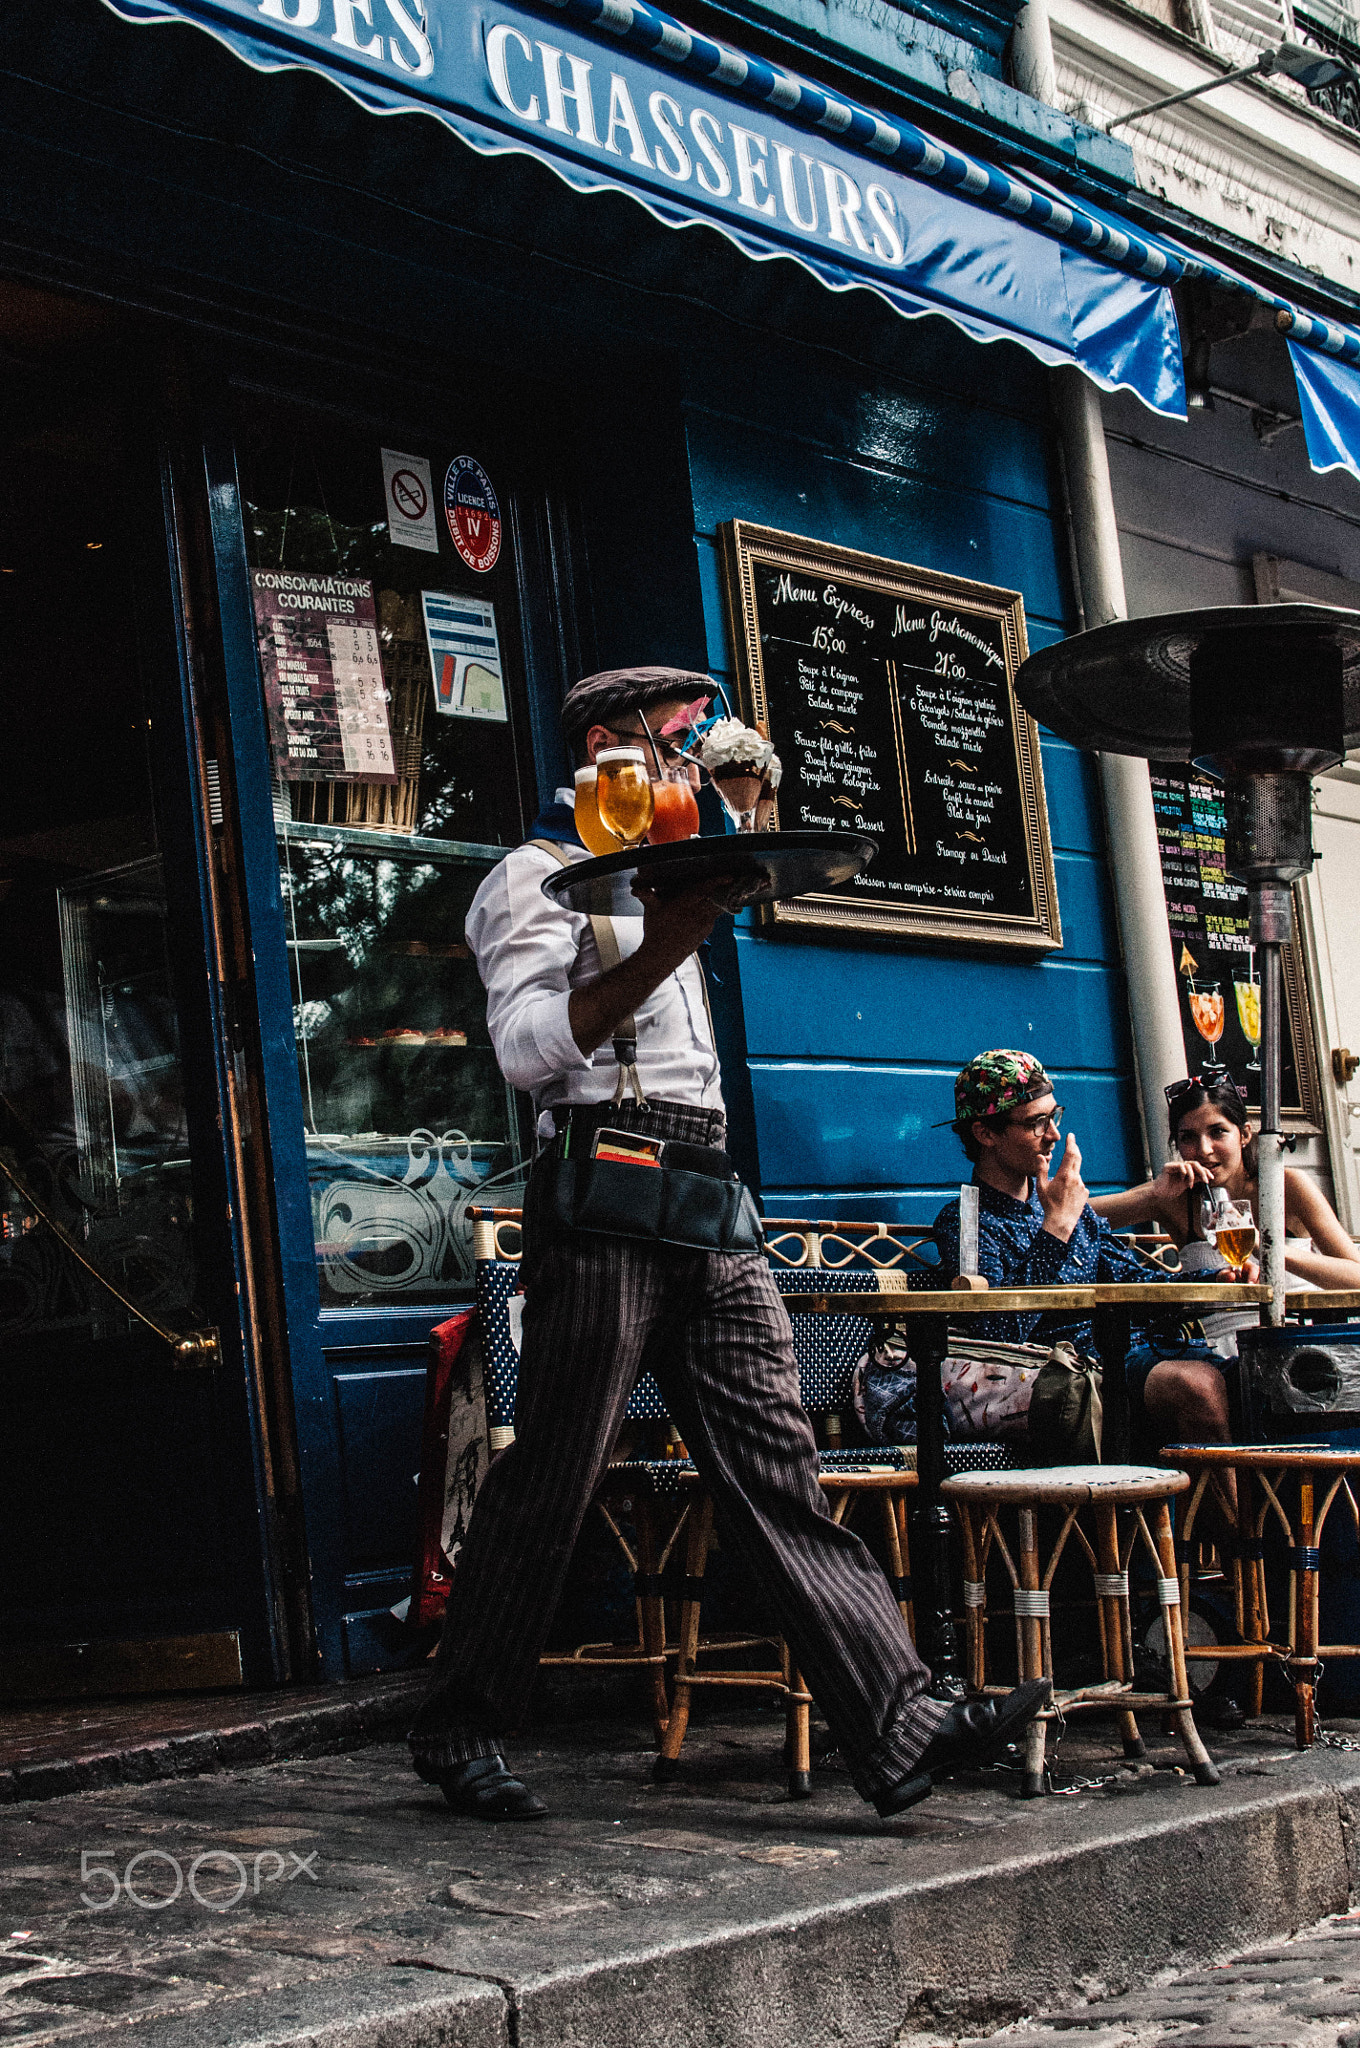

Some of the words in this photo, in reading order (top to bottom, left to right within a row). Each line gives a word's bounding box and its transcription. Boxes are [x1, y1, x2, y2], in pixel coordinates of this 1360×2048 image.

[258, 0, 433, 77] ES
[485, 24, 905, 266] CHASSEURS
[447, 464, 460, 501] VILLE
[459, 458, 474, 470] DE
[475, 469, 497, 511] PARIS
[457, 492, 486, 508] LICENCE
[467, 517, 480, 537] IV
[447, 509, 465, 547] DEBIT
[463, 548, 476, 566] DE
[477, 520, 500, 569] BOISSONS
[255, 572, 371, 598] CONSOMMATIONS
[278, 593, 355, 614] COURANTES
[772, 573, 818, 605] Menu
[823, 584, 875, 629] Express
[351, 629, 358, 638] 3
[366, 630, 372, 640] 3
[354, 640, 360, 651] 5
[368, 641, 373, 652] 5
[891, 604, 926, 638] Menu
[929, 610, 1005, 670] Gastronomique
[357, 677, 363, 688] 5
[371, 678, 377, 688] 5
[797, 658, 820, 679] Soupe
[822, 666, 828, 677] à
[830, 666, 859, 687] l'oignon
[360, 690, 366, 699] 5
[807, 693, 835, 711] Salade
[837, 702, 858, 715] mixte
[819, 681, 828, 694] de
[830, 687, 864, 705] campagne
[915, 684, 938, 704] Soupe
[939, 687, 945, 701] à
[946, 690, 974, 710] l'oignon
[362, 714, 369, 724] 5
[376, 714, 382, 724] 5
[910, 697, 917, 711] 6
[977, 714, 983, 723] de
[920, 714, 949, 732] Tomate
[951, 725, 987, 741] mozzarella
[287, 734, 311, 746] SANDWICH
[367, 738, 372, 749] 5
[380, 739, 385, 750] 5
[934, 732, 960, 749] Salade
[963, 739, 983, 753] mixte
[288, 746, 299, 758] PLAT
[306, 747, 318, 759] JOUR
[367, 751, 375, 761] 16
[380, 751, 389, 762] 16
[800, 766, 836, 789] Spaghetti
[842, 773, 881, 796] bolognèse
[958, 780, 977, 791] sauce
[984, 781, 1003, 798] poivre
[943, 787, 963, 808] Confit
[964, 793, 973, 805] de
[973, 797, 995, 809] canard
[800, 805, 837, 832] Fromage
[841, 819, 851, 828] ou
[854, 814, 886, 833] Dessert
[946, 801, 965, 820] Plat
[965, 808, 975, 821] du
[975, 809, 991, 830] jour
[936, 840, 967, 865] Fromage
[970, 852, 979, 861] ou
[982, 847, 1008, 865] Dessert
[853, 872, 887, 889] Boisson
[888, 881, 903, 891] non
[904, 882, 936, 897] comprise
[944, 885, 967, 899] Service
[968, 890, 995, 905] compris
